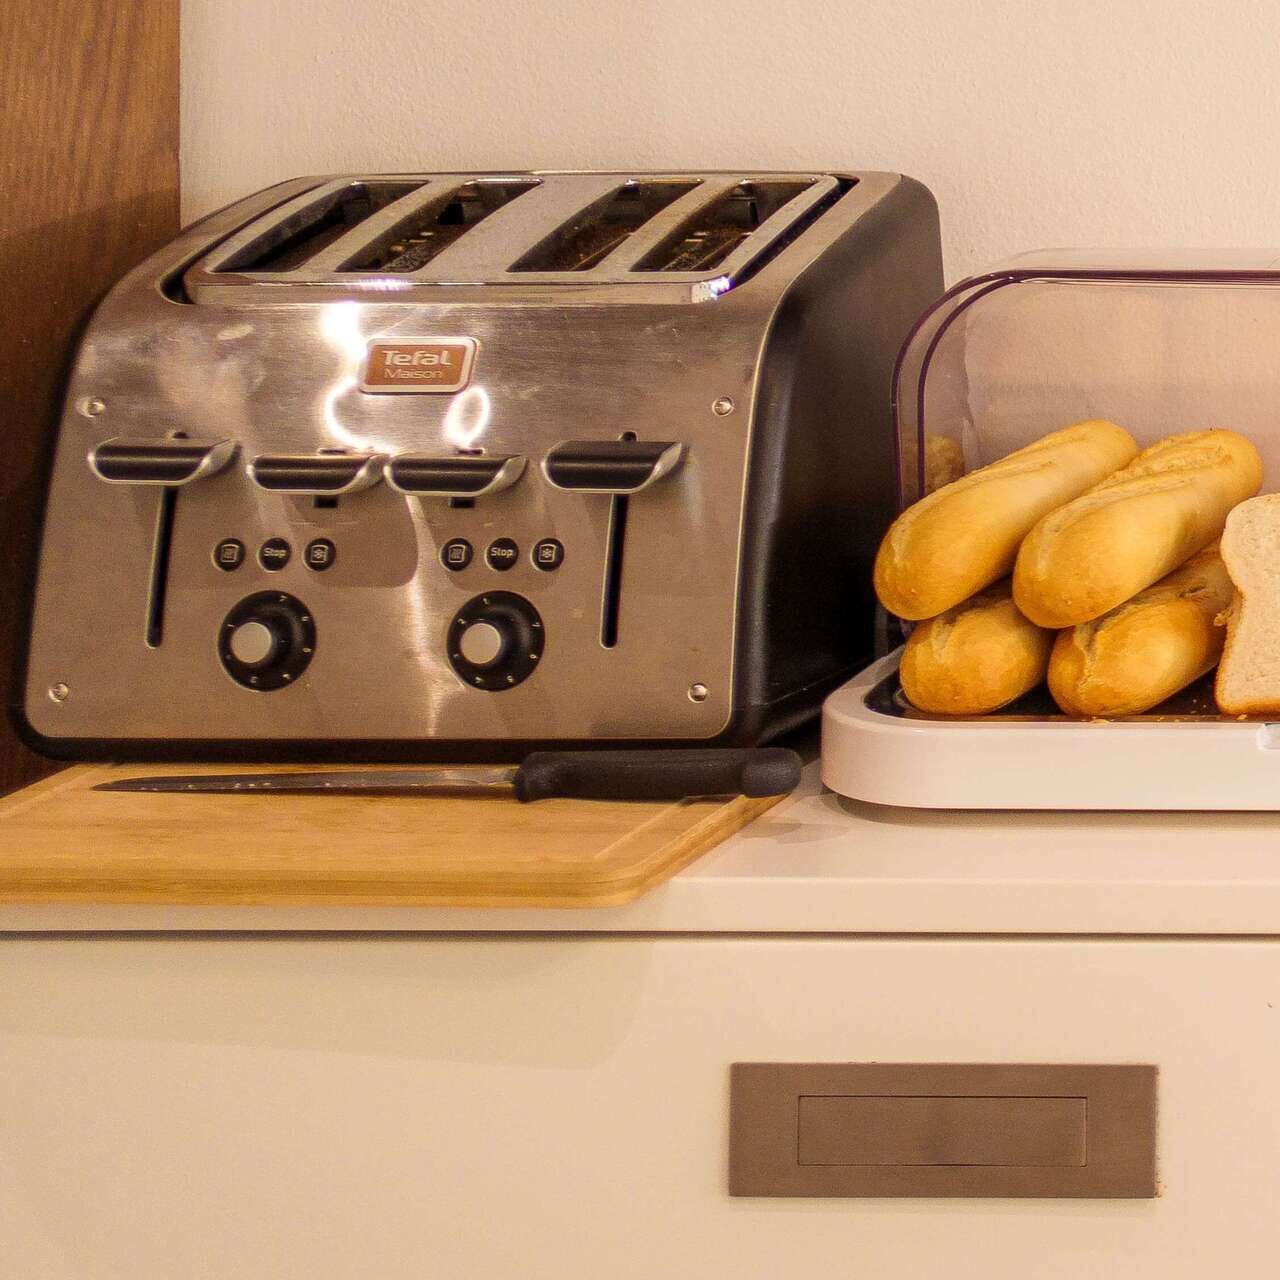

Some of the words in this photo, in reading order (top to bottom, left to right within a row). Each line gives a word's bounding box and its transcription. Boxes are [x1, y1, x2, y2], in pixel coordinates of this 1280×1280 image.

[381, 350, 453, 366] Tefal
[384, 368, 442, 379] Maison
[263, 547, 287, 559] Stop
[490, 547, 514, 559] Stop
